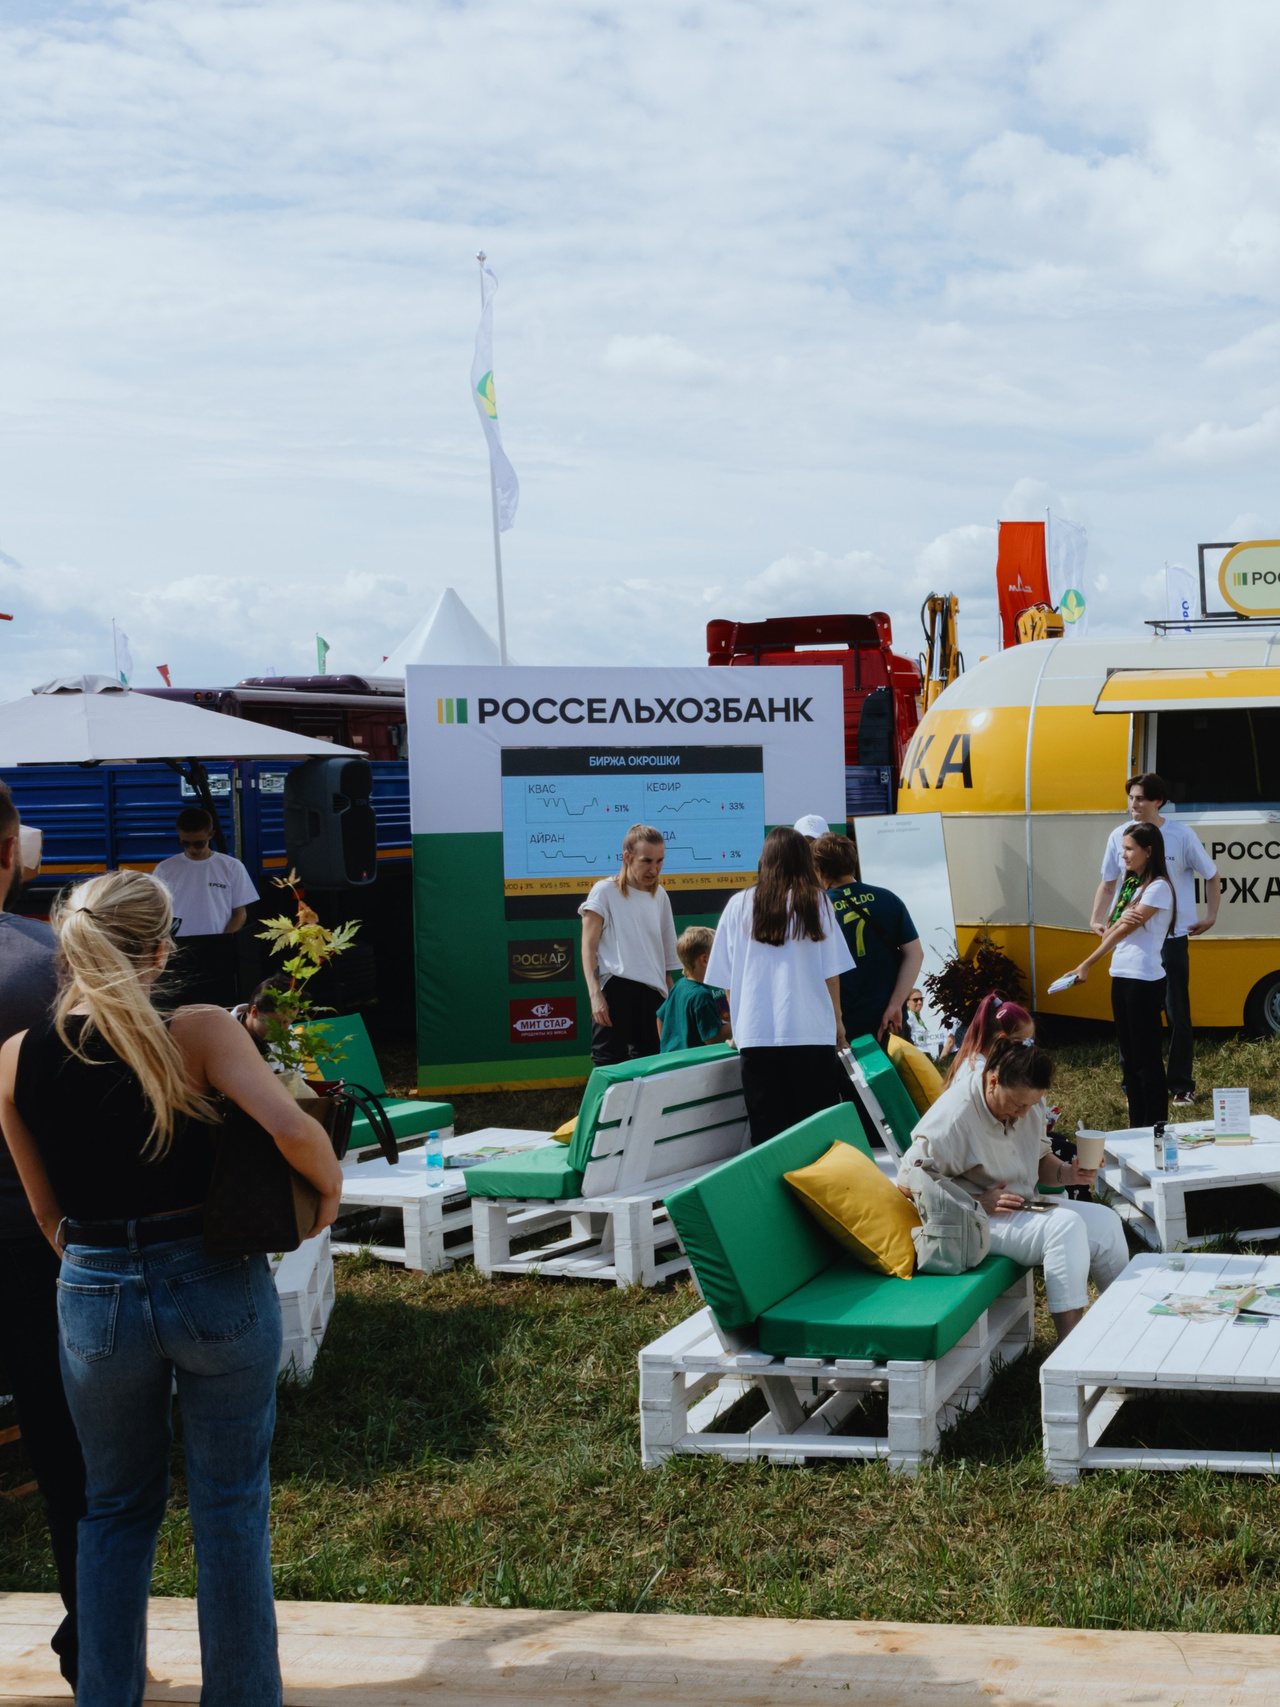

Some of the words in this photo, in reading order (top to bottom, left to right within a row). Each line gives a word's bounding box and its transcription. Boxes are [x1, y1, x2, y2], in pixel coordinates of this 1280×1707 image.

[478, 697, 815, 725] РОССЕЛЬХОЗБАНК
[589, 756, 626, 767] БИРЖА
[628, 755, 680, 766] ОКРОШКИ
[528, 784, 556, 794] КВАС
[646, 782, 681, 792] КЕФИР
[614, 804, 630, 813] 51%
[729, 802, 745, 811] 33%
[530, 832, 565, 843] АЙРАН
[662, 831, 676, 841] ДА
[730, 851, 741, 859] 3%
[833, 893, 875, 911] ONLDO
[843, 907, 871, 957] 7
[512, 953, 567, 965] РОСКАР
[520, 1020, 541, 1030] МИТ
[543, 1019, 568, 1028] СТАР
